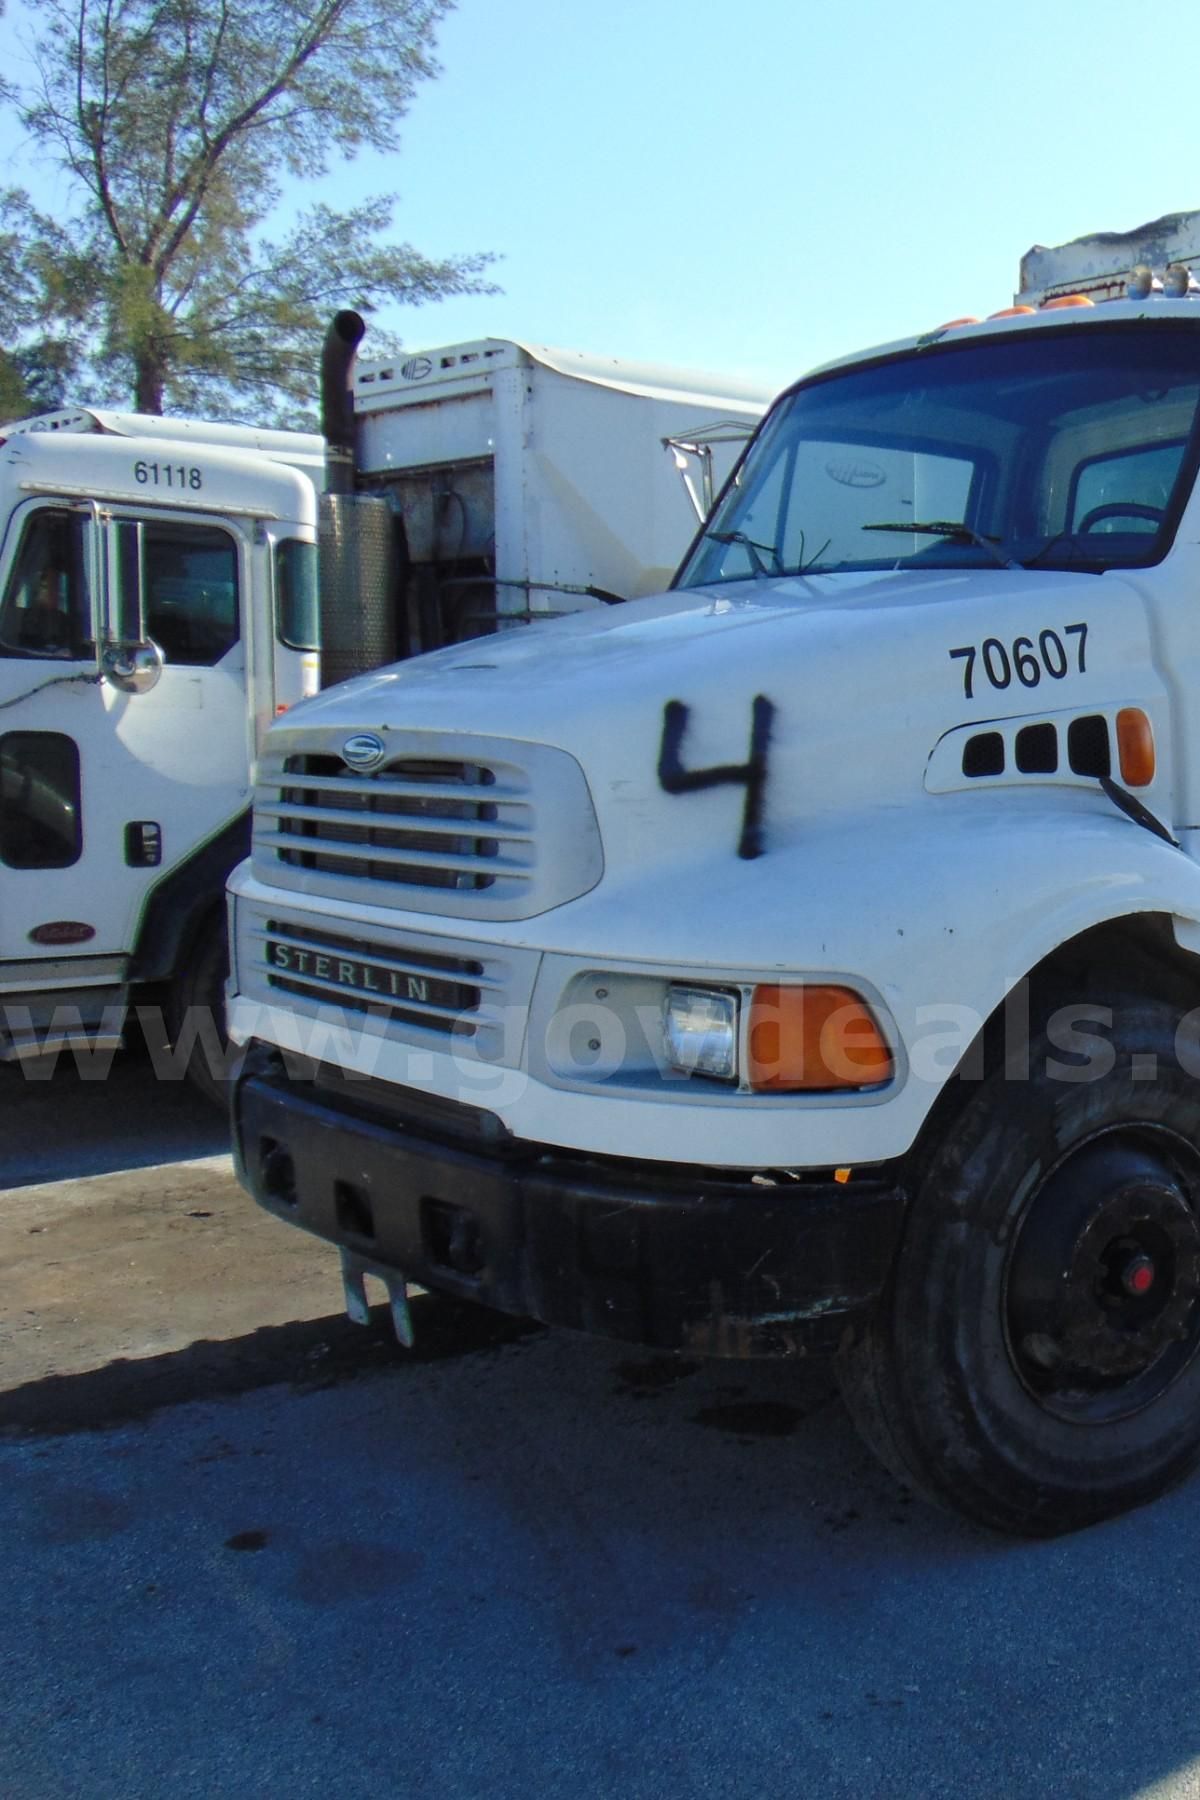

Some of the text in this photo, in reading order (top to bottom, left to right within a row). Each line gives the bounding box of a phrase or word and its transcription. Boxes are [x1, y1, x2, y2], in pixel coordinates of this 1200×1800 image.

[134, 460, 202, 490] 61118
[949, 622, 1089, 699] 70607
[658, 694, 774, 859] 4
[274, 944, 428, 1001] STERLIN
